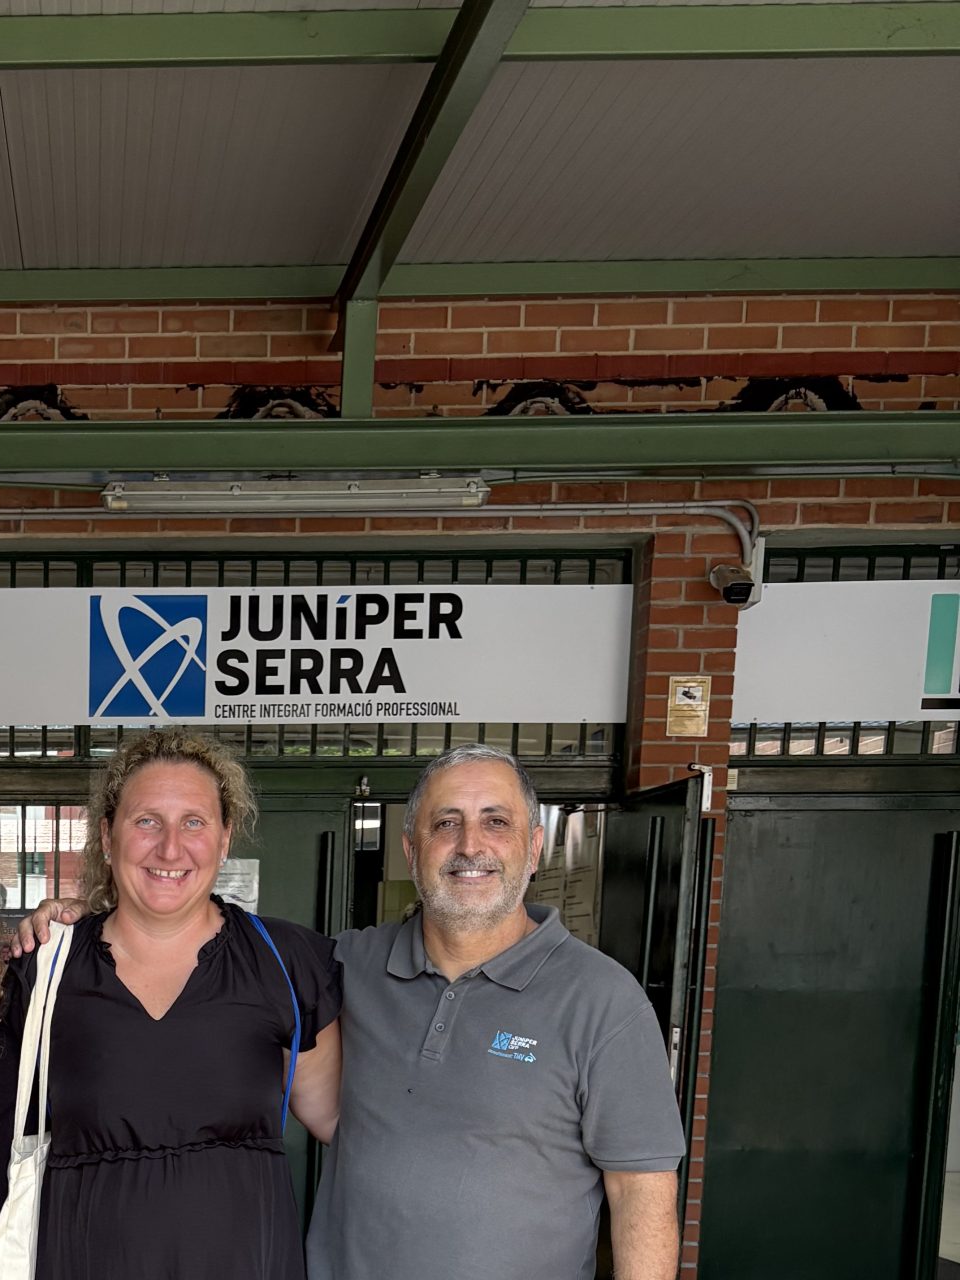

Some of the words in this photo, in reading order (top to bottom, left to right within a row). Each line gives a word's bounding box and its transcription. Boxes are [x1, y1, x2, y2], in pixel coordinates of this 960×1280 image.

[215, 648, 407, 696] SERRA
[214, 704, 257, 718] CENTRE
[259, 703, 312, 718] INTEGRAT
[314, 700, 373, 717] FORMACIÓ
[376, 701, 461, 716] PROFESSIONAL
